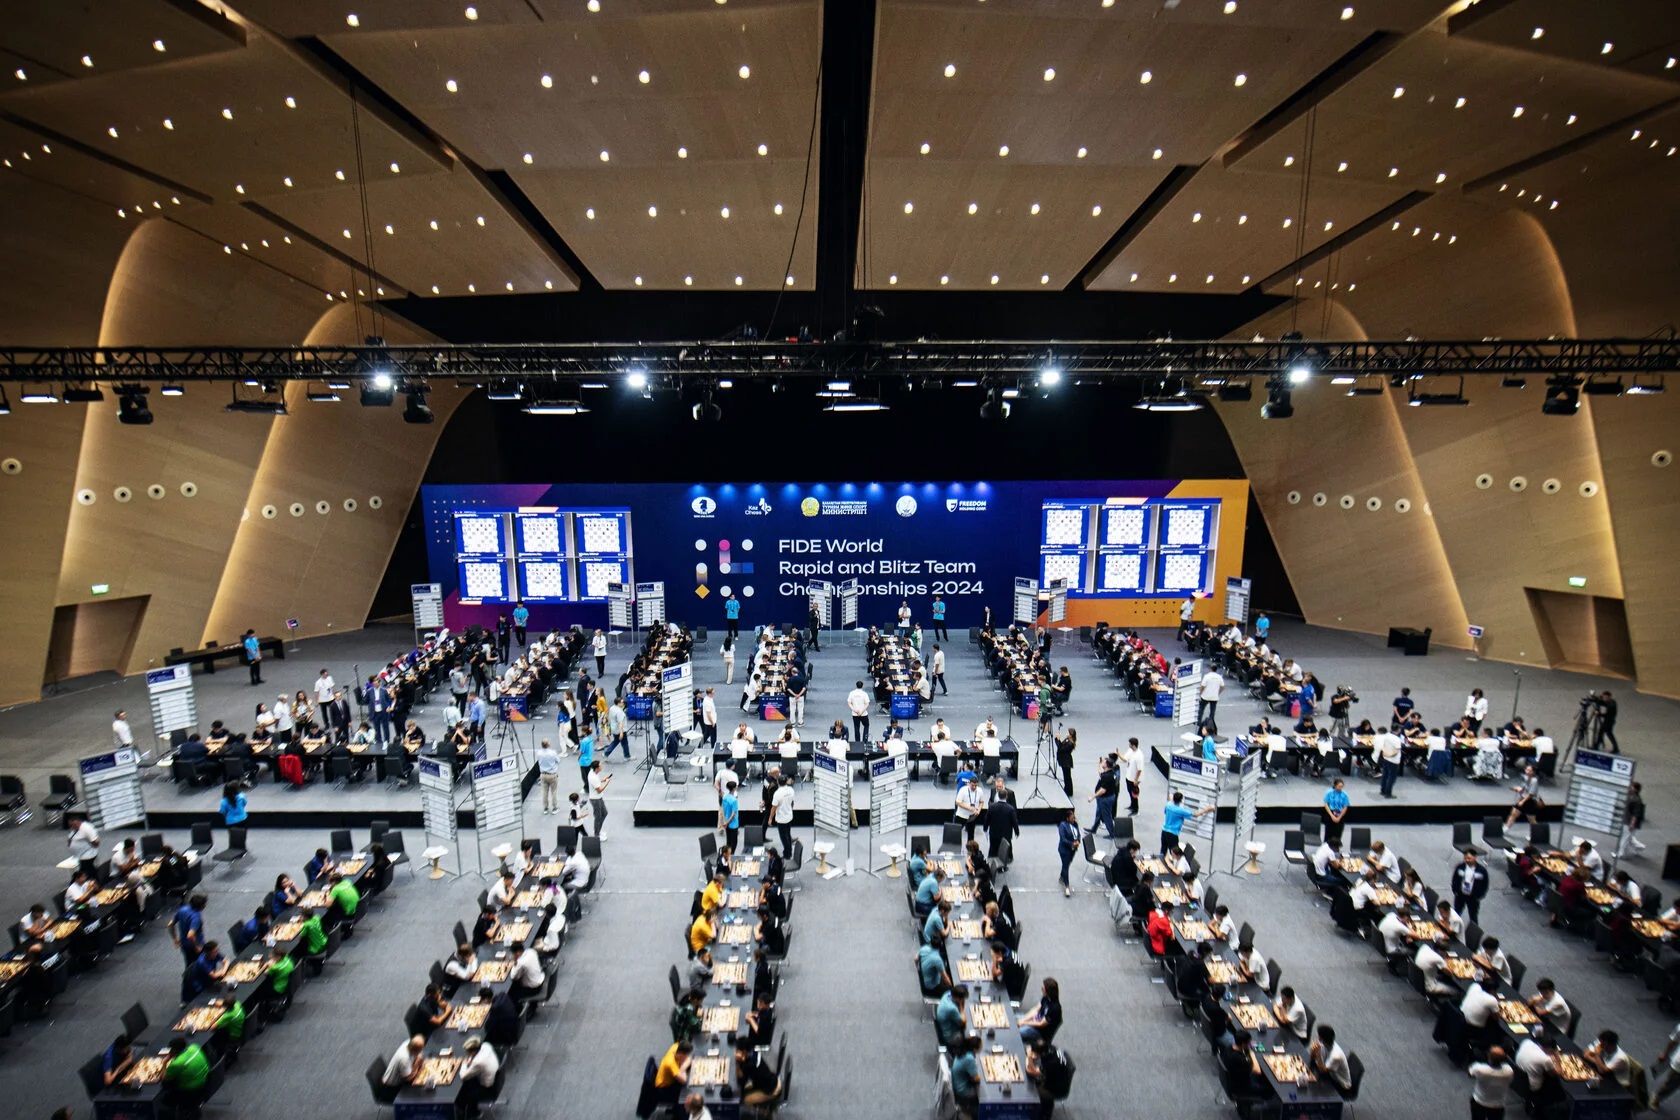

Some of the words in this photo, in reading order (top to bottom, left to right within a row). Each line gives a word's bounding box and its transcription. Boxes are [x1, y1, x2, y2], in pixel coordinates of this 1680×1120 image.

[779, 539, 822, 553] FIDE
[825, 538, 883, 553] World
[779, 560, 834, 577] Rapid
[837, 560, 875, 574] and
[879, 560, 921, 574] Blitz
[923, 560, 976, 574] Team
[931, 581, 984, 595] 2024
